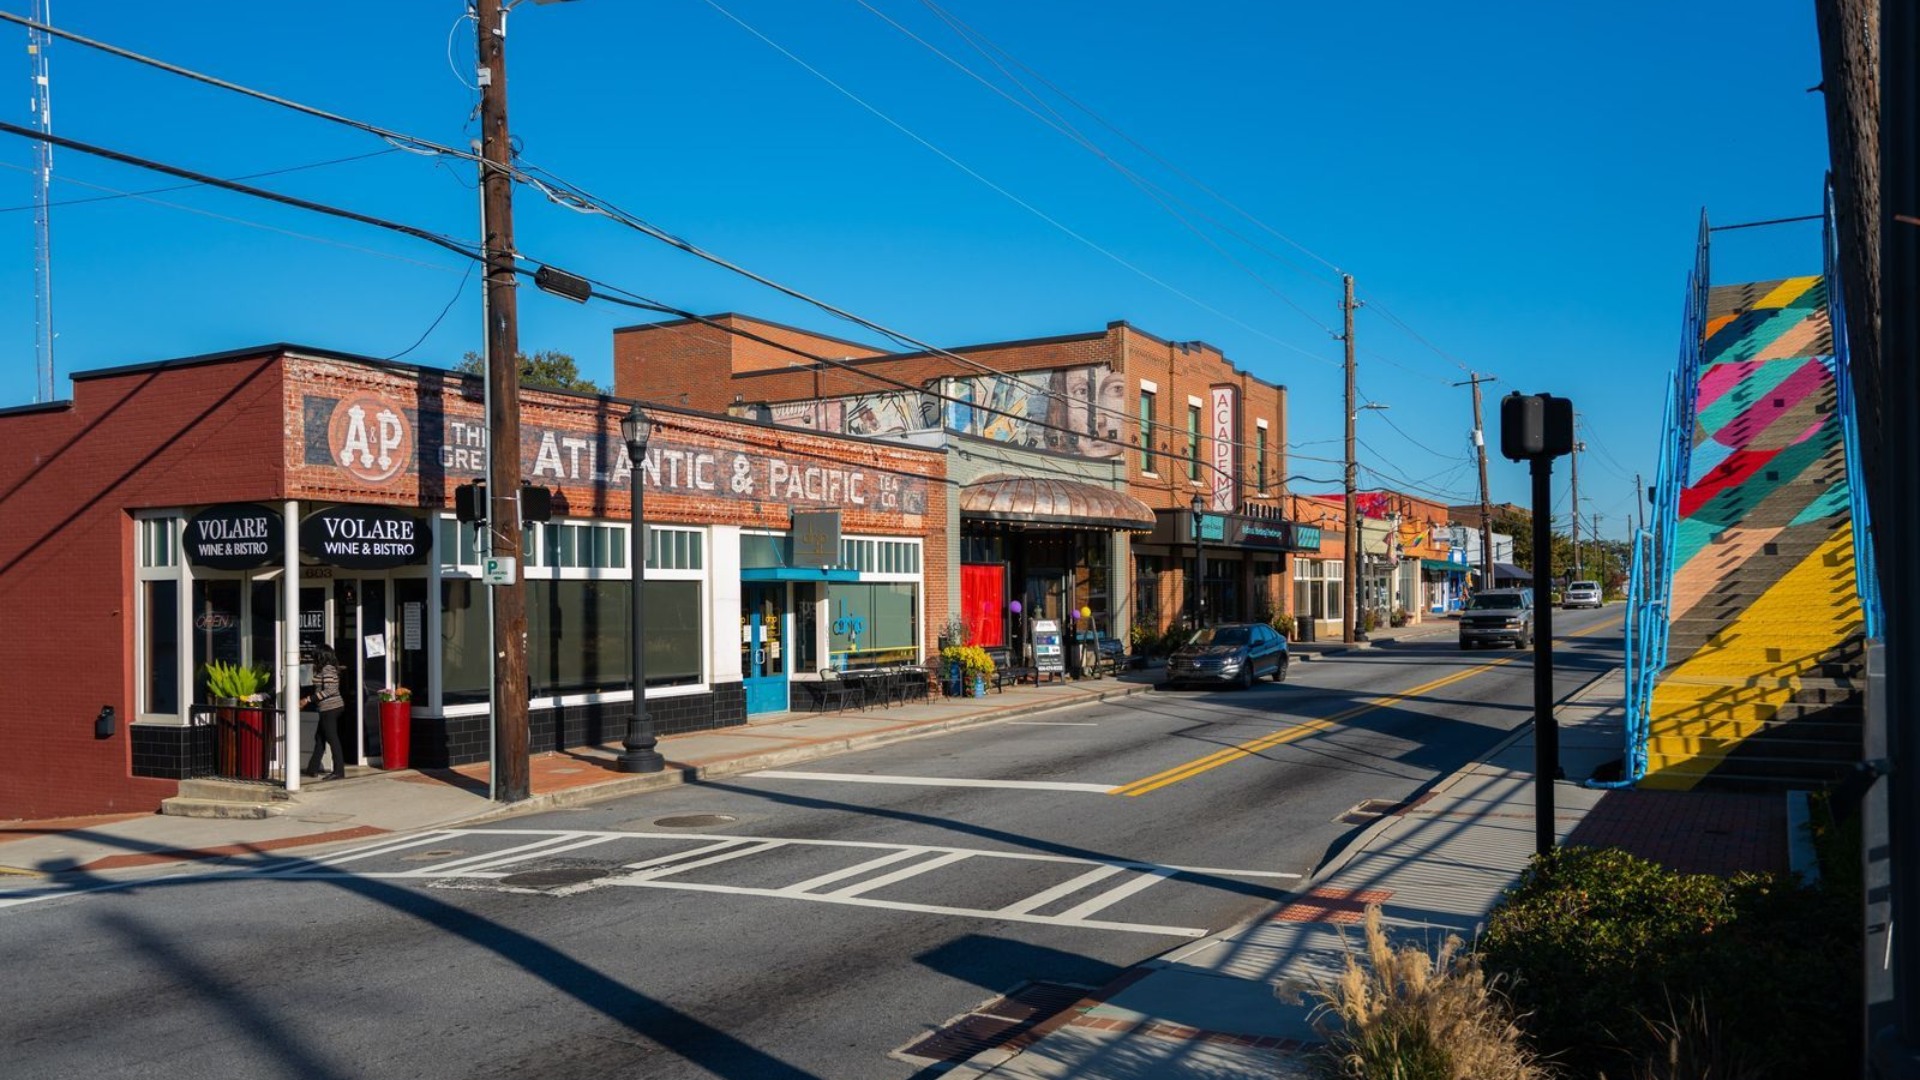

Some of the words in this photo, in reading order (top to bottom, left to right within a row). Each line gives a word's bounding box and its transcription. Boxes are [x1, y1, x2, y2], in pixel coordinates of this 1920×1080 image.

[451, 422, 485, 447] TH
[1216, 393, 1231, 510] ACADEMY
[532, 430, 715, 491] ATLANTIC
[732, 454, 754, 494] &
[768, 458, 865, 505] PACIFIC
[879, 473, 898, 491] TEA
[881, 492, 898, 509] CO.
[198, 517, 267, 540] VOLARE
[323, 517, 415, 540] VOLARE
[198, 543, 224, 556] WINE
[225, 543, 233, 555] &
[234, 541, 268, 555] BISTRO
[325, 542, 360, 555] WINE
[362, 542, 372, 555] &
[374, 543, 415, 556] BISTRO
[306, 567, 332, 578] 603
